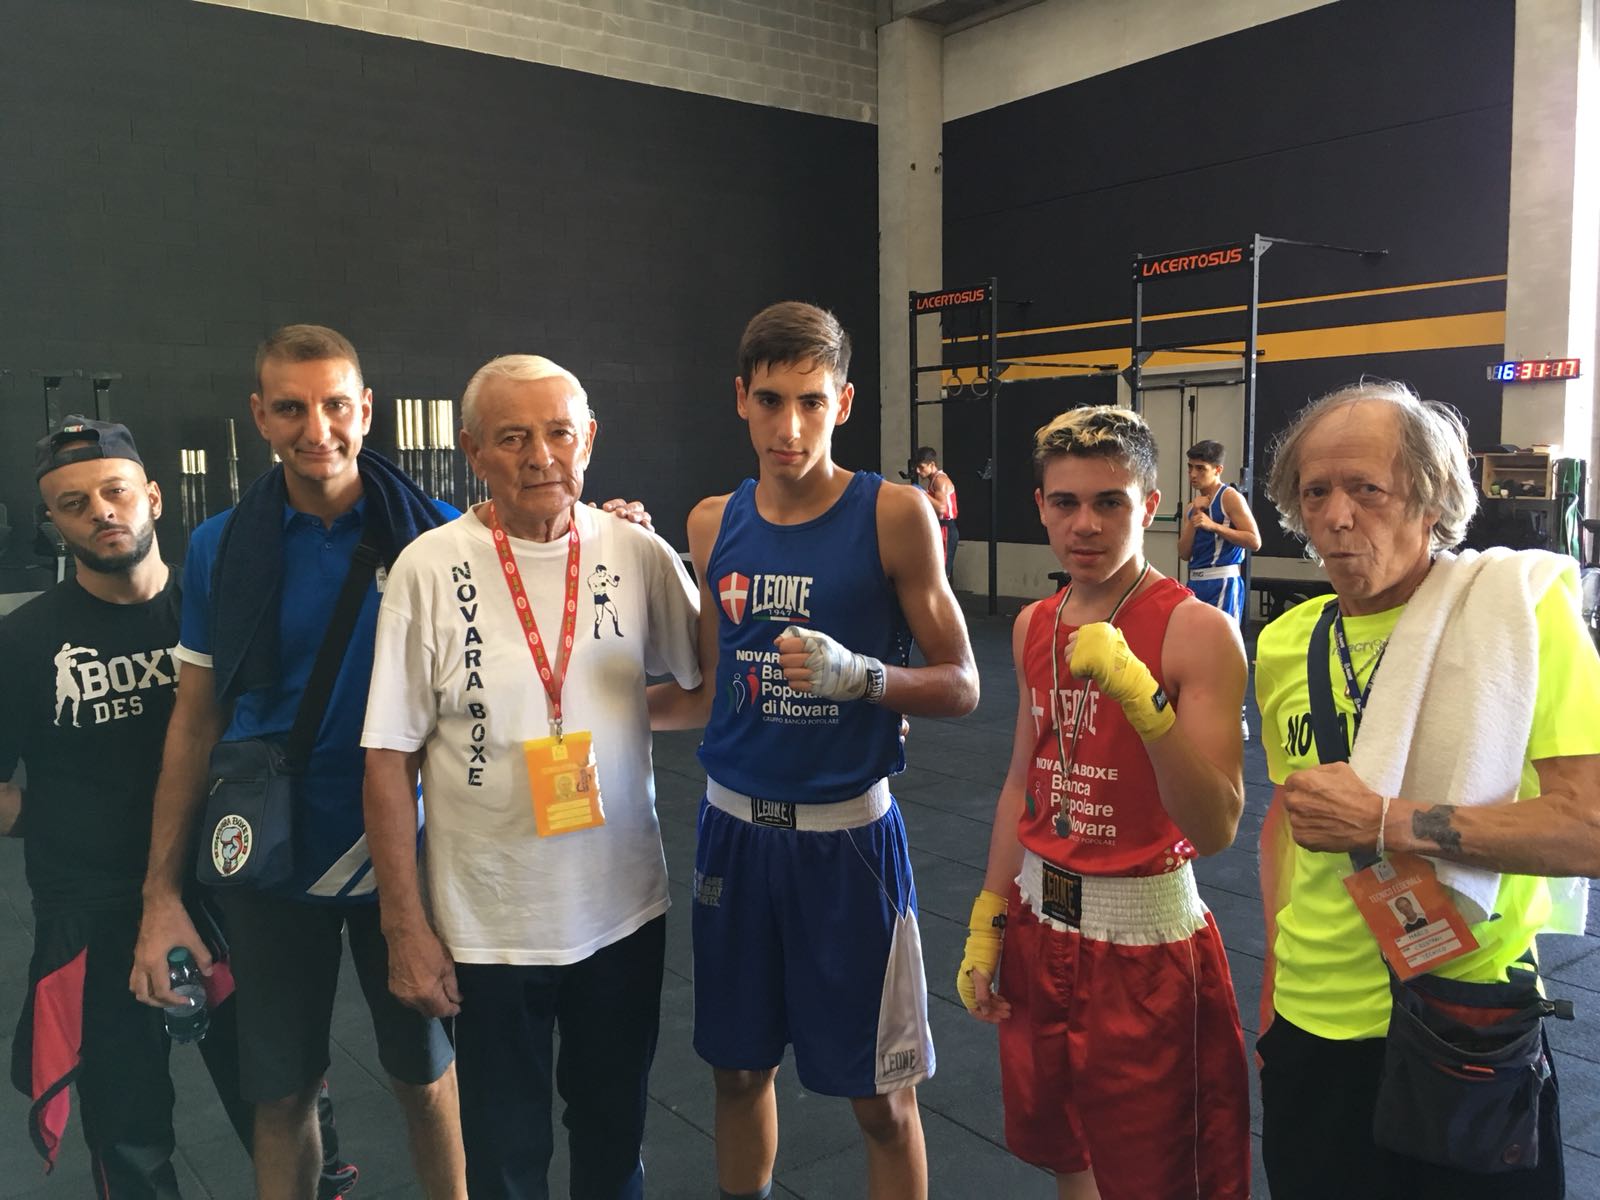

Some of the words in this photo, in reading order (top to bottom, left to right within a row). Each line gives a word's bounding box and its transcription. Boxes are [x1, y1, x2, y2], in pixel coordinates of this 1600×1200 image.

[1142, 248, 1243, 277] LACERTOSUS
[916, 288, 985, 311] LACERTOSUS
[1496, 360, 1578, 380] 16:31:17
[751, 574, 814, 618] LEONE
[767, 608, 793, 616] 1947
[451, 560, 484, 692] NOVARA
[736, 649, 780, 664] NOVAR
[761, 664, 787, 681] Ba
[93, 695, 144, 724] DES
[762, 699, 777, 714] di
[780, 700, 840, 717] Novara
[466, 702, 487, 787] BOXE
[1036, 757, 1119, 781] NOVAABOXE
[1051, 773, 1092, 797] Banca
[757, 798, 789, 822] LEONE
[880, 1048, 916, 1078] LEONE
